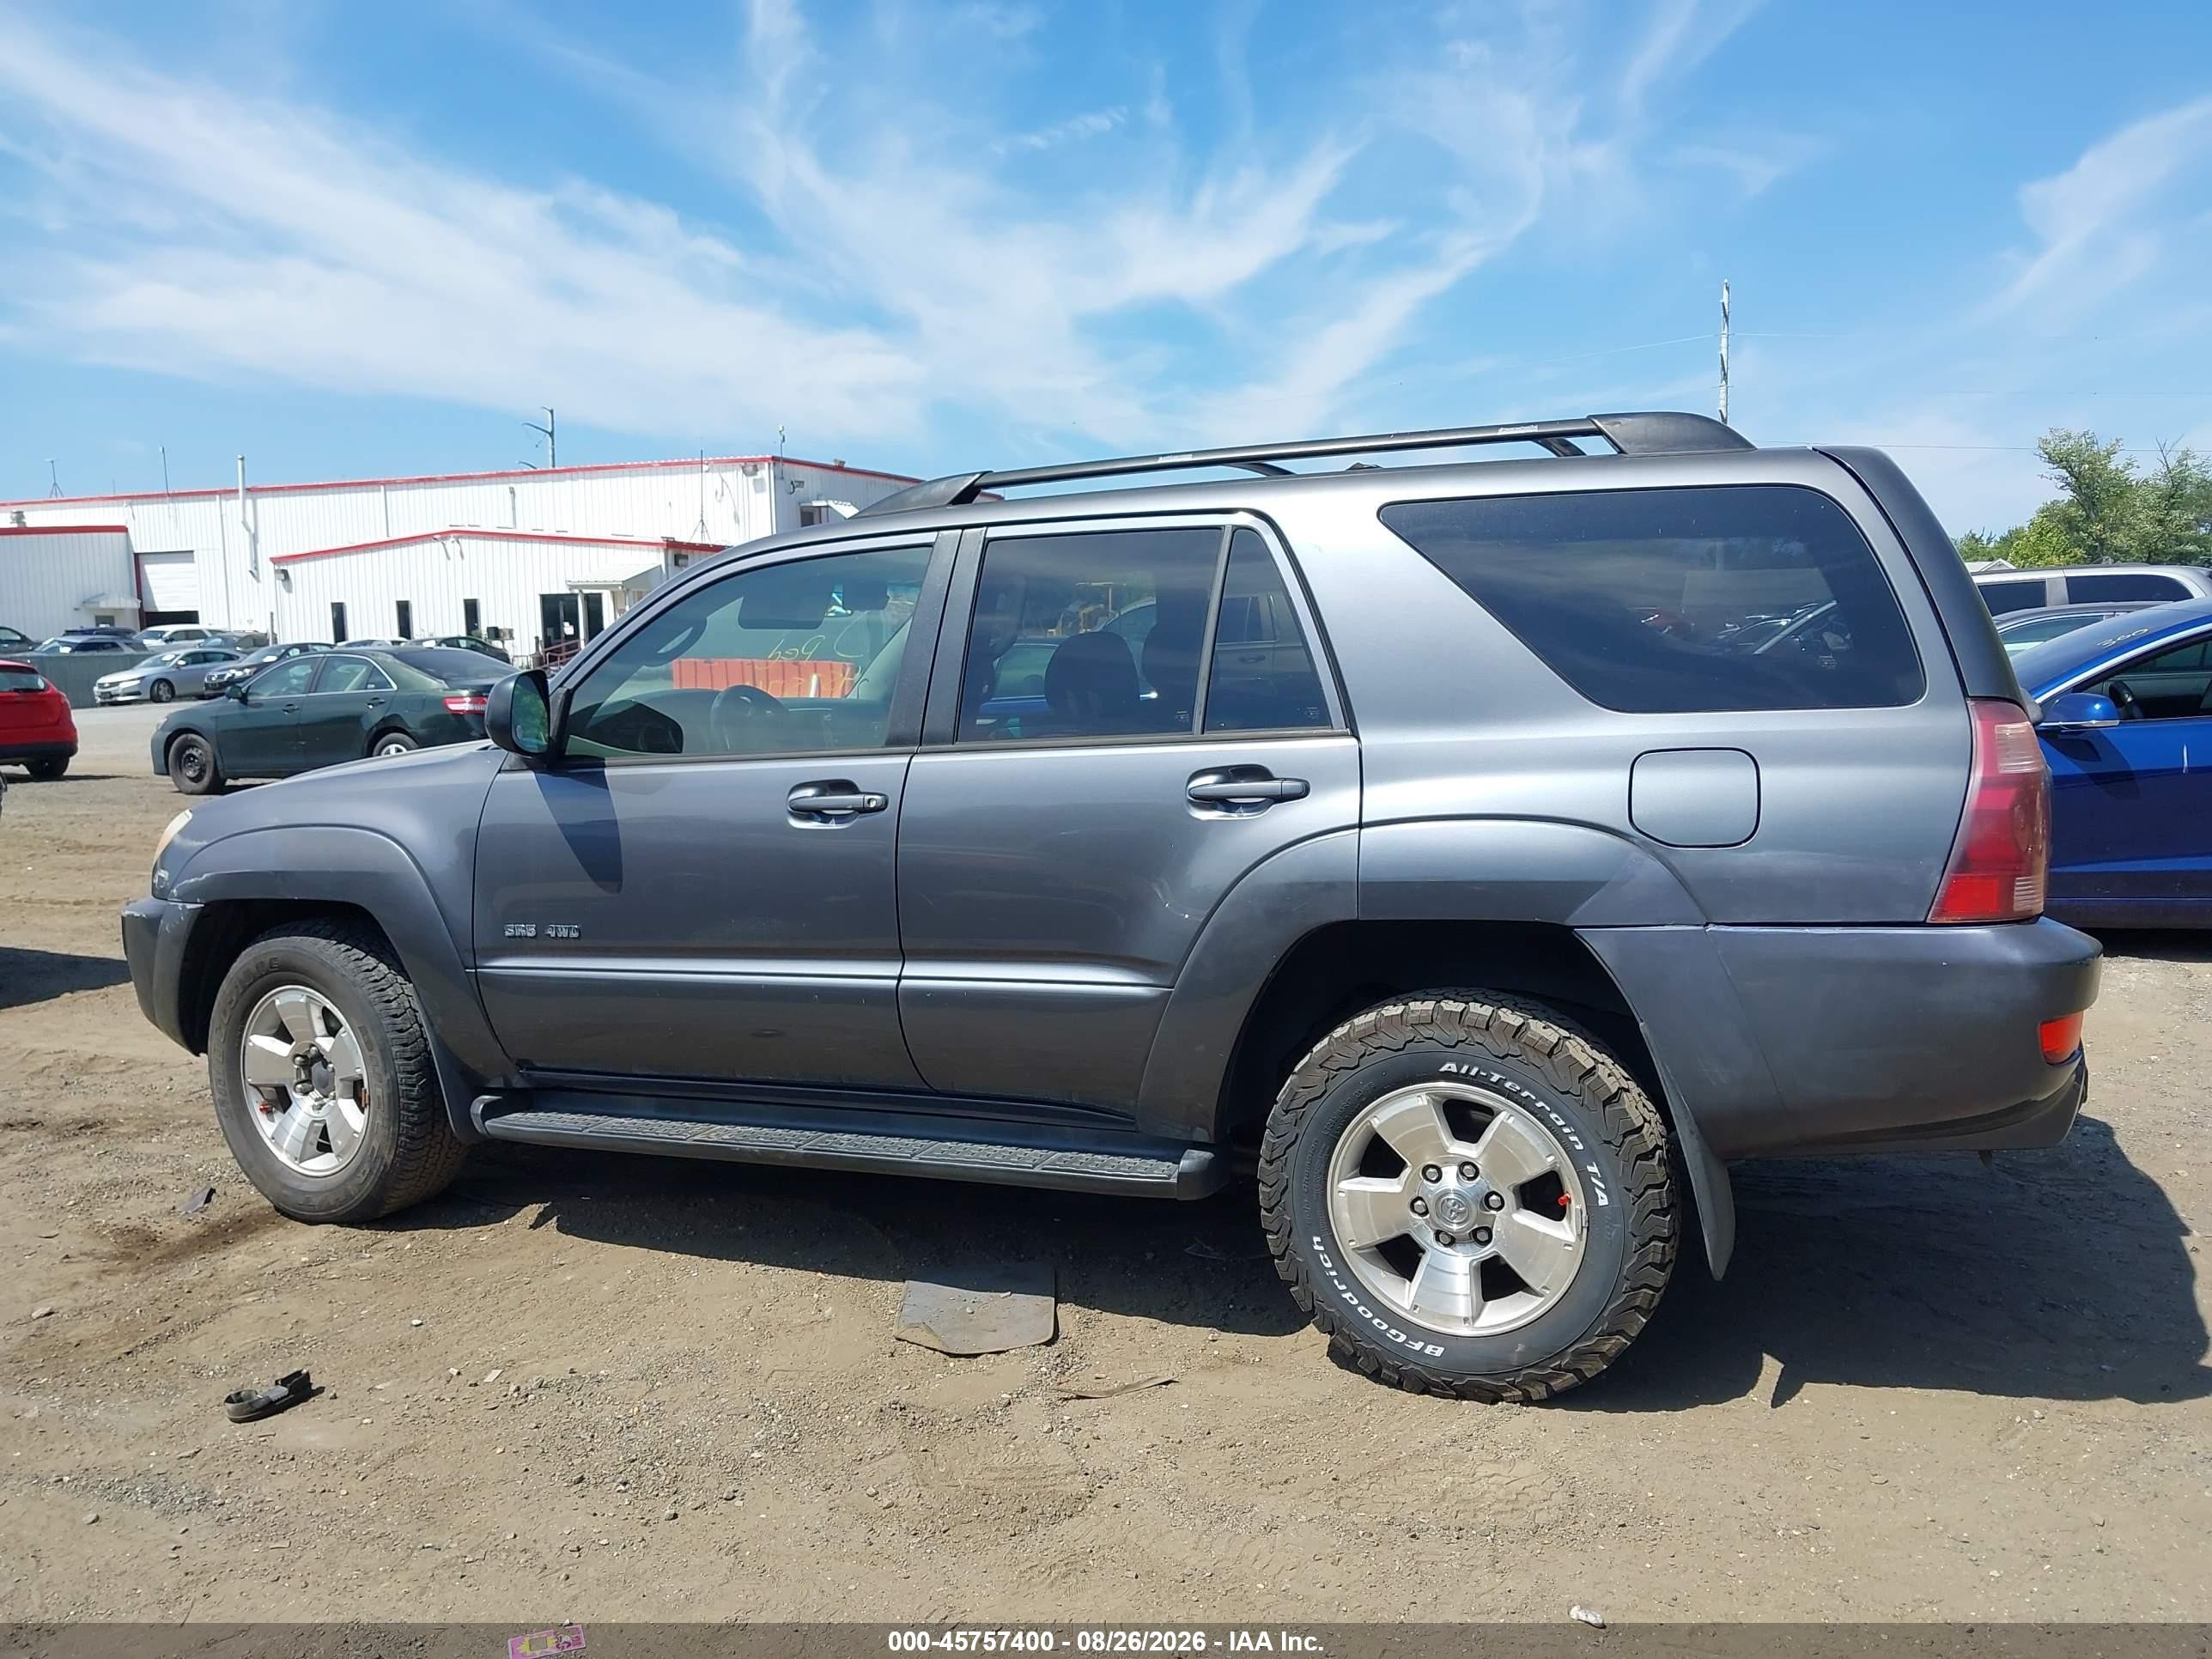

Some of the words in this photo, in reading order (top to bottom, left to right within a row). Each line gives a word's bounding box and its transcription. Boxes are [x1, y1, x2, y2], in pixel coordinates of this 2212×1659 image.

[504, 924, 537, 937] SR5
[544, 924, 580, 938] 4WD
[1437, 1060, 1583, 1152] All-Terrain
[1585, 1161, 1609, 1207] T/A
[1312, 1235, 1446, 1358] BFGoodrich
